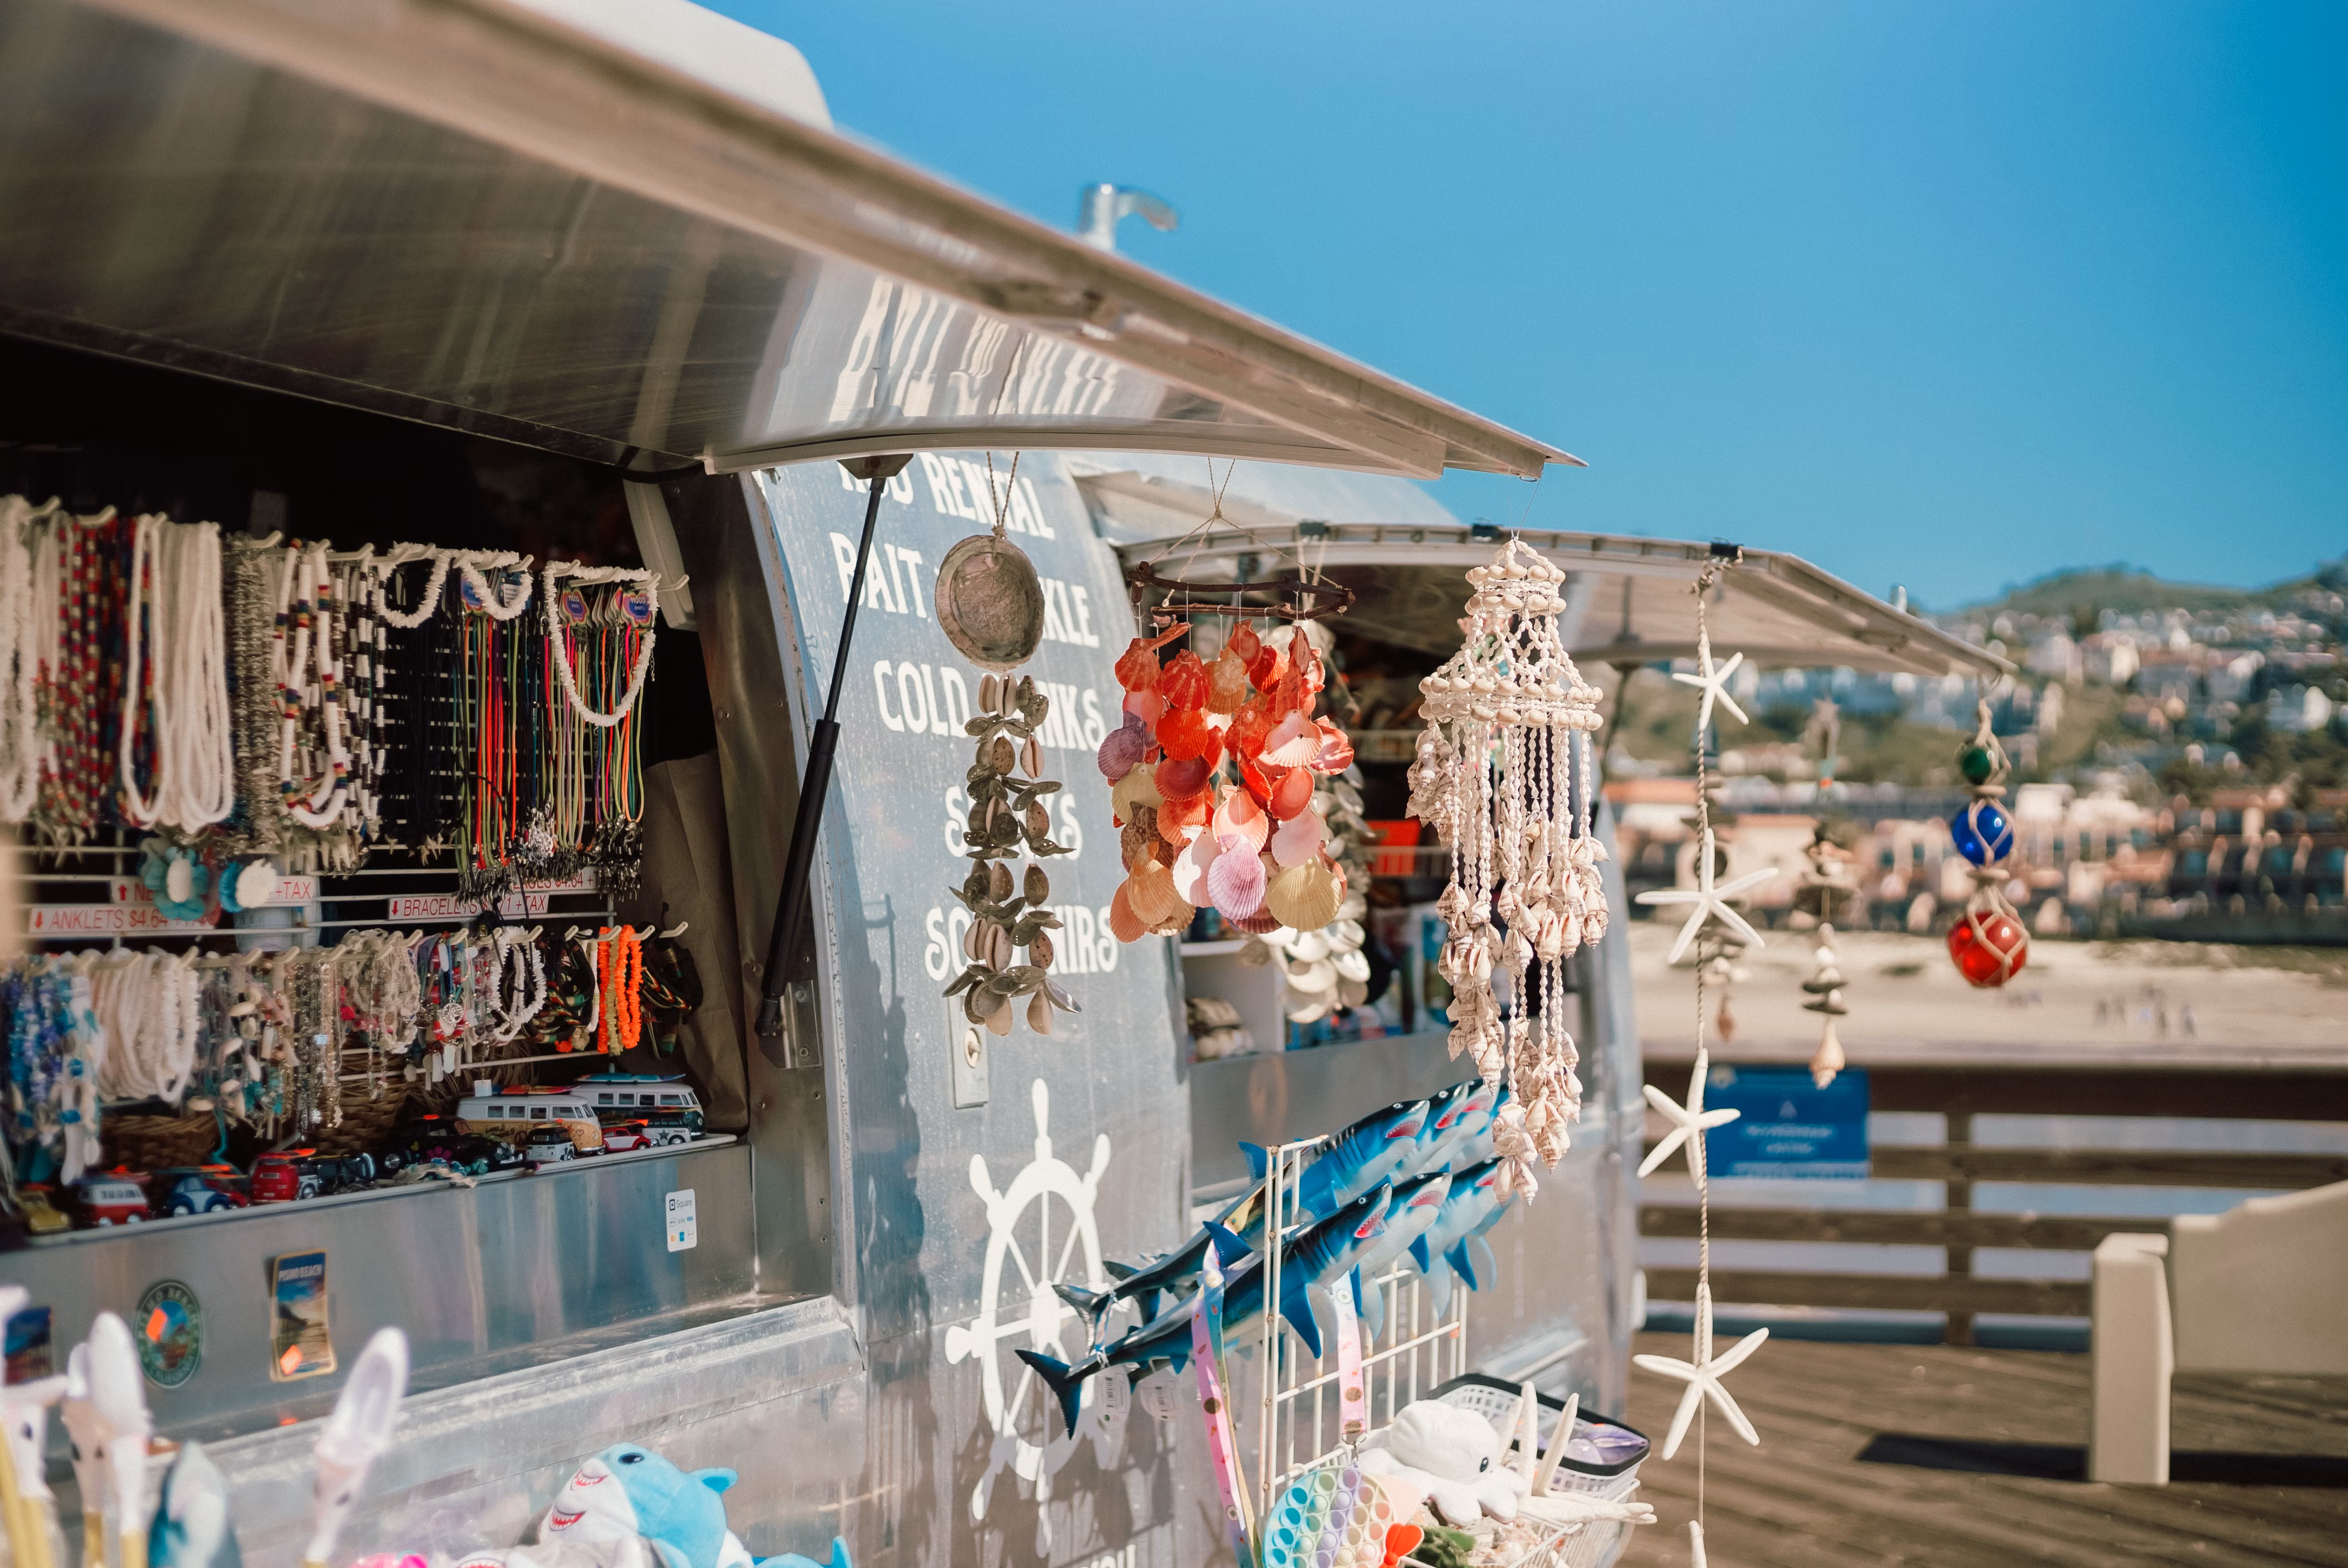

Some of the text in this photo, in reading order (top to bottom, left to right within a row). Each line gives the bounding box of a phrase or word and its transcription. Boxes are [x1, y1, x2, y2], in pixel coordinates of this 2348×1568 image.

[918, 452, 1055, 540] RENTAL
[830, 532, 927, 618] BAIT
[873, 659, 971, 739] COLD
[49, 909, 123, 930] ANKLETS
[925, 904, 1119, 981] SONIRS
[676, 1199, 692, 1209] Square
[300, 1263, 322, 1278] BEACH
